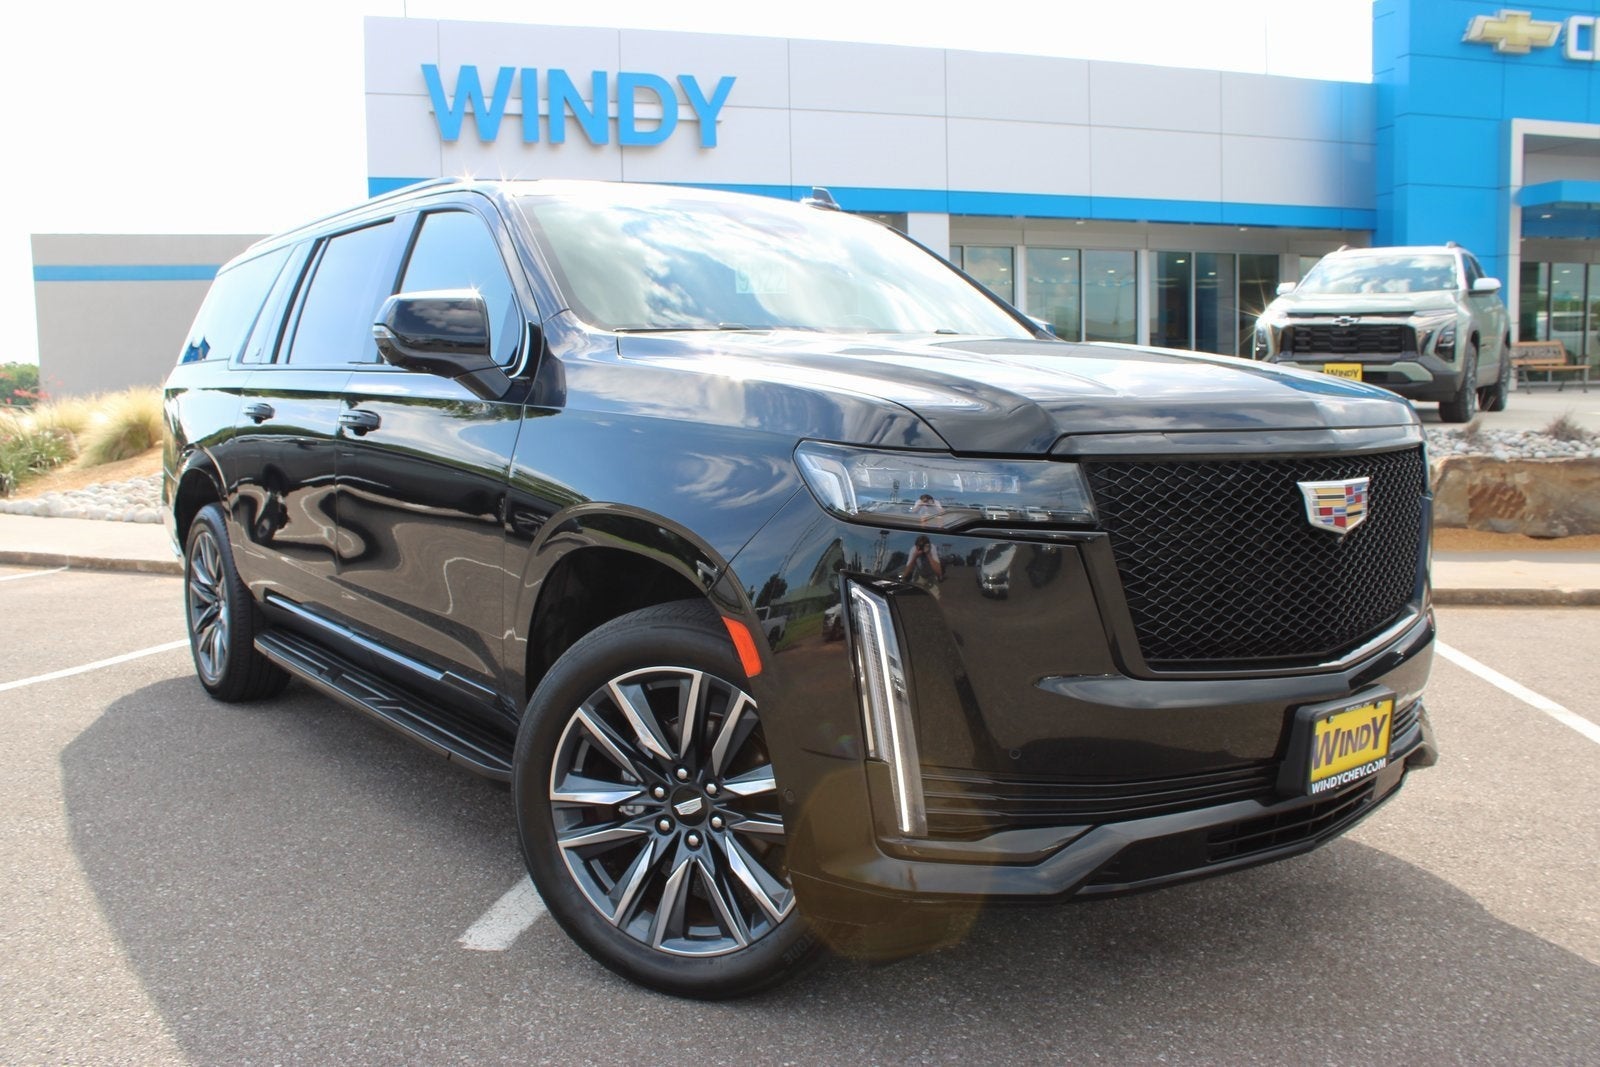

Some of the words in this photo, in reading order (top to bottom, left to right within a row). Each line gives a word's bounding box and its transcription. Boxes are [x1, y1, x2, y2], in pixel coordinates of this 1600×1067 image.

[1567, 15, 1600, 61] C
[420, 63, 737, 149] WINDY
[1312, 714, 1388, 770] WINDY
[1311, 757, 1387, 794] WINDYCHEV.COM
